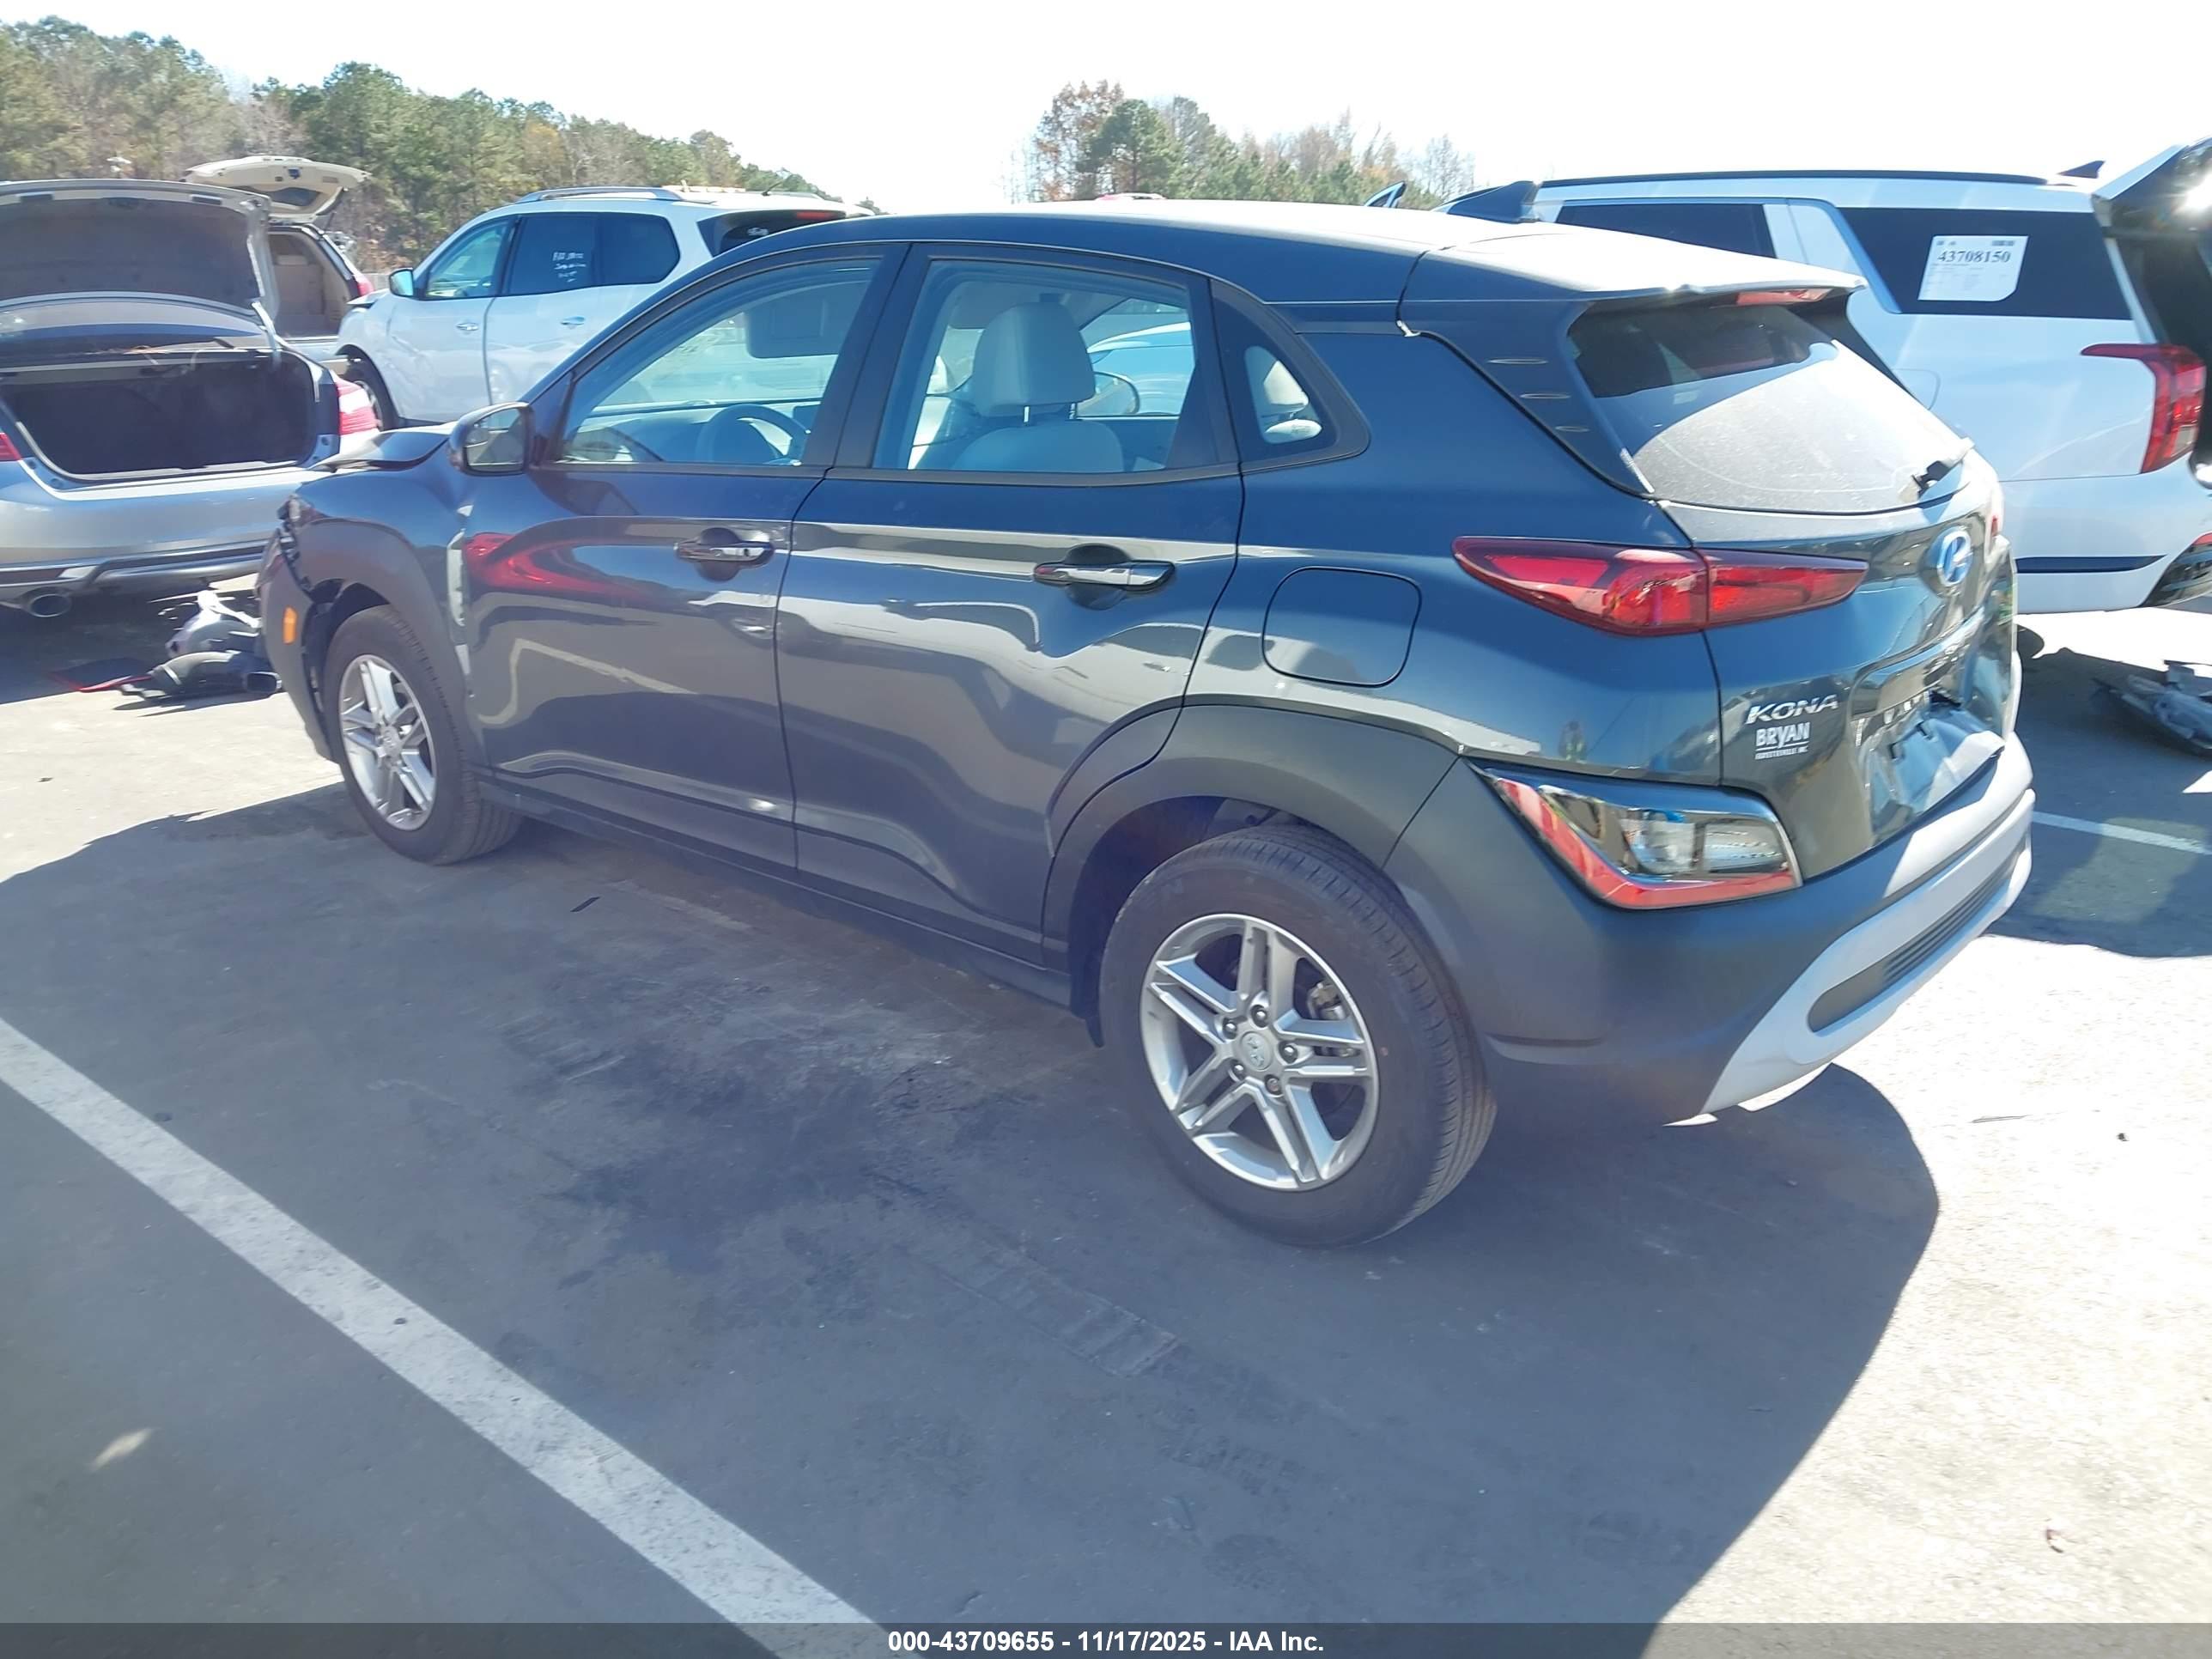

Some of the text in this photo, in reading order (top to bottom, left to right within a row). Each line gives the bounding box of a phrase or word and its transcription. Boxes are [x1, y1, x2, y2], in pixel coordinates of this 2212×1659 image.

[1937, 250, 2011, 263] 43708150
[1745, 694, 1838, 725] KONA
[1756, 721, 1810, 748] BRYAN
